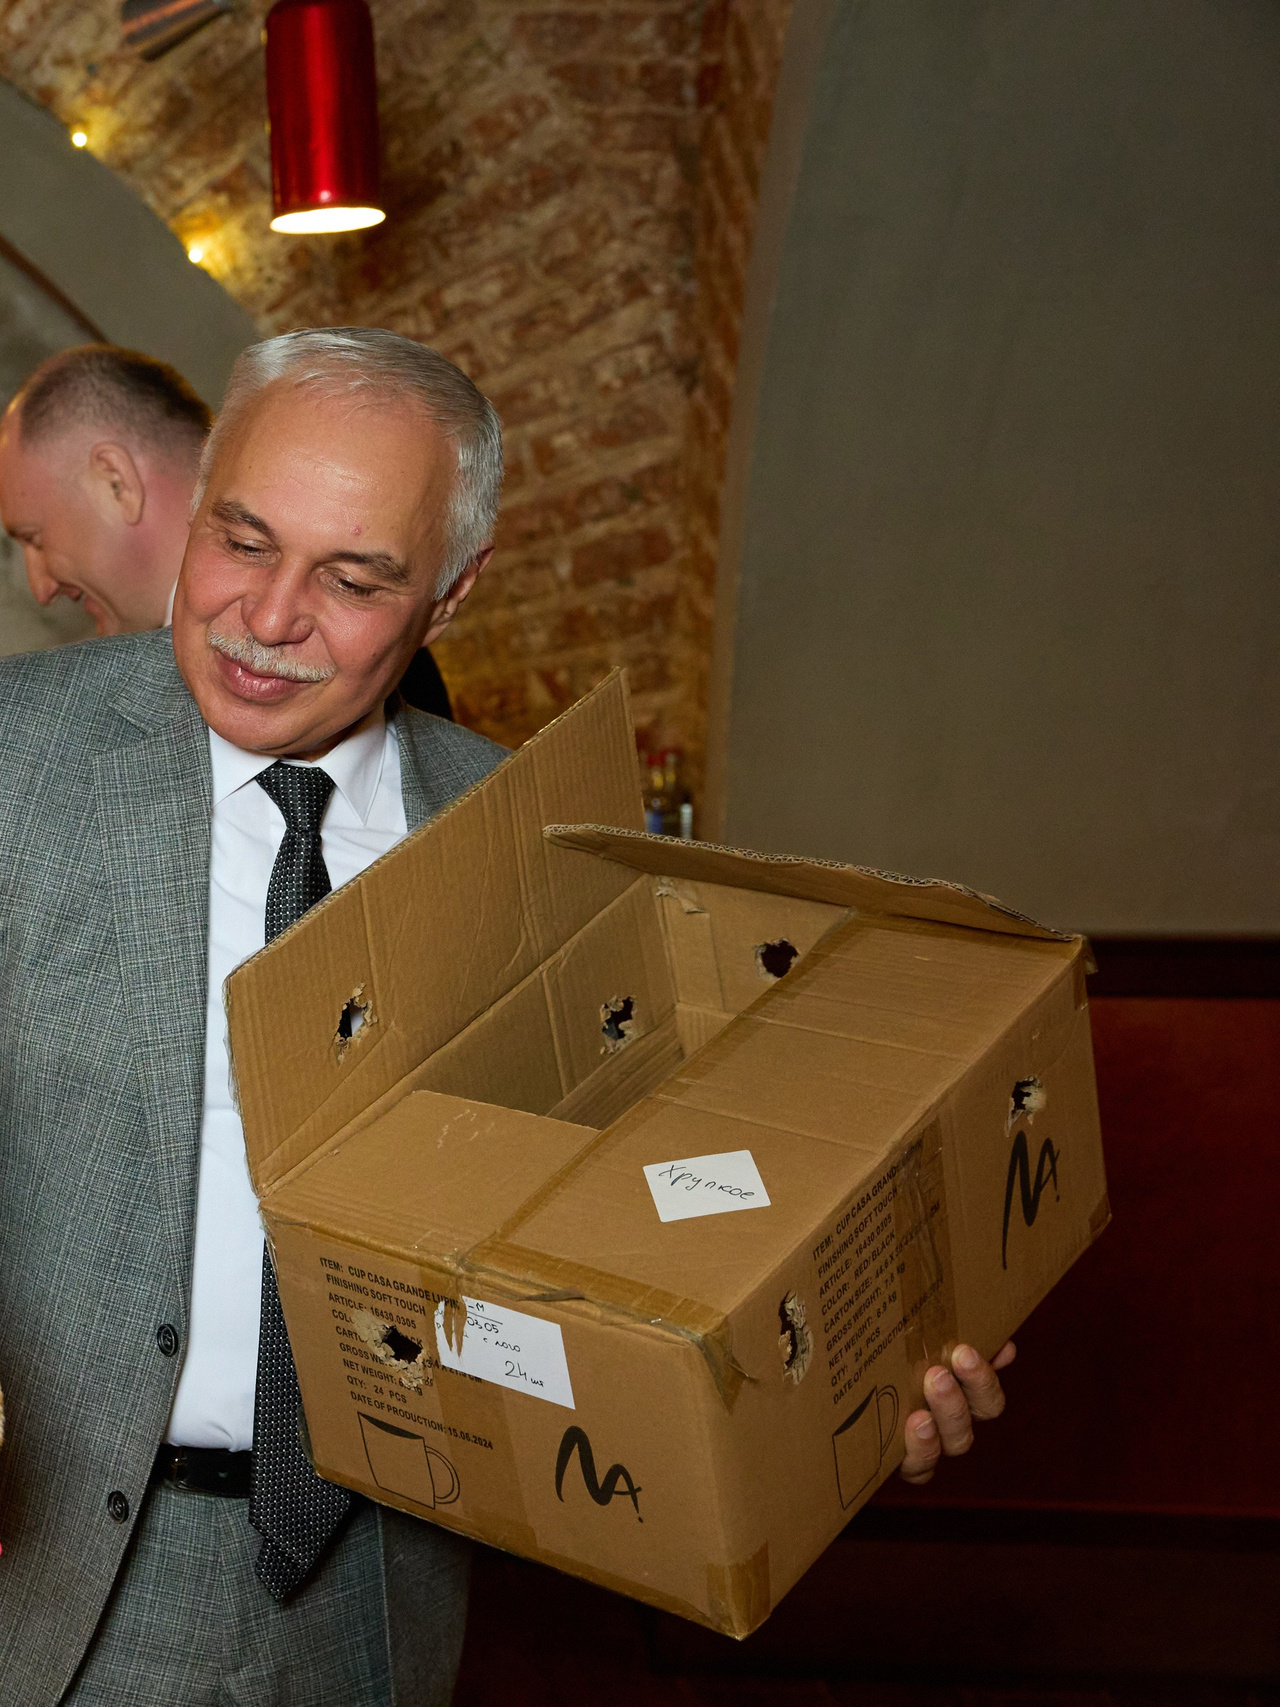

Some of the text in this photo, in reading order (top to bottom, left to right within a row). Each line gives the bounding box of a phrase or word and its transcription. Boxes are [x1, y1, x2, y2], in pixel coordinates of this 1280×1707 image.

[658, 1164, 755, 1200] Хрупкое
[812, 1235, 833, 1260] ITEM:
[836, 1214, 851, 1235] CUP
[851, 1192, 872, 1218] CASA
[818, 1186, 898, 1278] FINISHING SOFT TOUCH
[319, 1257, 344, 1273] ITEM:
[348, 1265, 366, 1279] CUP
[367, 1272, 392, 1289] CASA
[394, 1280, 431, 1301] GRANDE
[326, 1273, 369, 1296] FINISHING
[370, 1289, 392, 1305] SOFT
[394, 1297, 426, 1316] TOUCH
[820, 1258, 852, 1298] ARTICLE:
[821, 1282, 850, 1316] COLOR:
[872, 1229, 896, 1261] BLACK
[370, 1306, 417, 1329] 16430.0305
[824, 1297, 854, 1334] CARTON
[854, 1277, 873, 1300] SIZE:
[826, 1320, 853, 1352] GROSS
[852, 1287, 882, 1324] WEIGHT:
[339, 1342, 369, 1360] GROSS
[828, 1348, 844, 1370] NET
[844, 1316, 873, 1353] WEIGHT:
[876, 1301, 887, 1318] 6.9
[831, 1365, 849, 1387] QTY:
[866, 1327, 881, 1349] PCS
[343, 1358, 359, 1373] NET
[361, 1366, 397, 1385] WEIGHT:
[833, 1378, 853, 1405] DATE
[853, 1366, 863, 1383] OF
[863, 1313, 910, 1372] PRODUCTION:
[346, 1375, 407, 1404] QTY: 24 PCS
[350, 1391, 373, 1407] DATE
[373, 1399, 385, 1412] OF
[386, 1404, 447, 1434] PRODUCTION:
